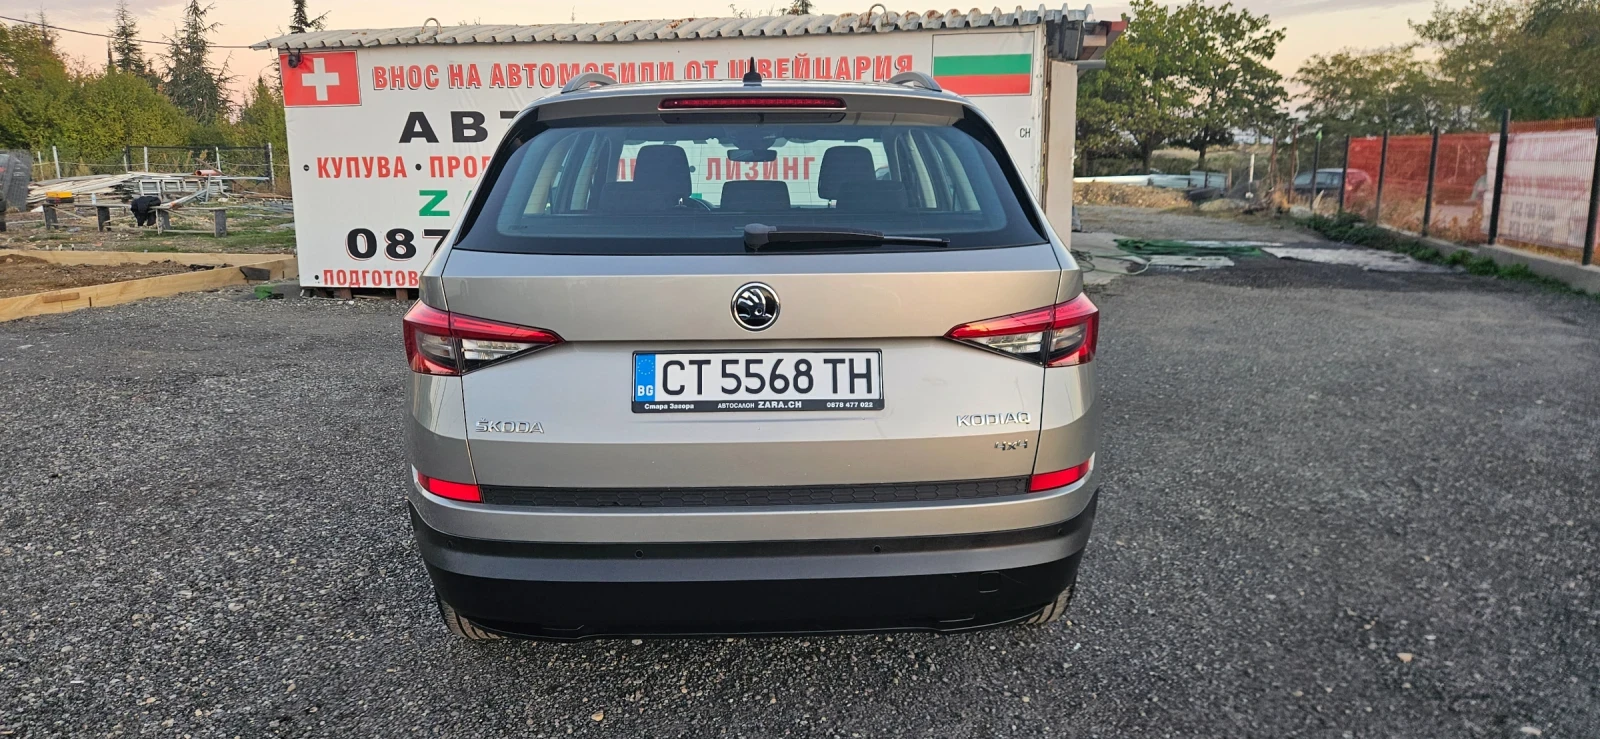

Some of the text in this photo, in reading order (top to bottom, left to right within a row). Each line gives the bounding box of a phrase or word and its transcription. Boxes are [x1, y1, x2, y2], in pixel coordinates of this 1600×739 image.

[373, 64, 439, 90] ВНОС
[448, 63, 482, 90] НА
[684, 60, 718, 80] ОТ
[728, 53, 913, 81] ШВЕЙЦАРИЯ
[1019, 128, 1031, 138] CH
[316, 156, 407, 179] КУПУВА
[705, 157, 815, 181] ЛИЗИНГ
[662, 358, 873, 396] CT 5568 TH
[637, 385, 654, 397] BG
[475, 417, 545, 434] ŠKODA
[956, 411, 1032, 428] KODIAQ
